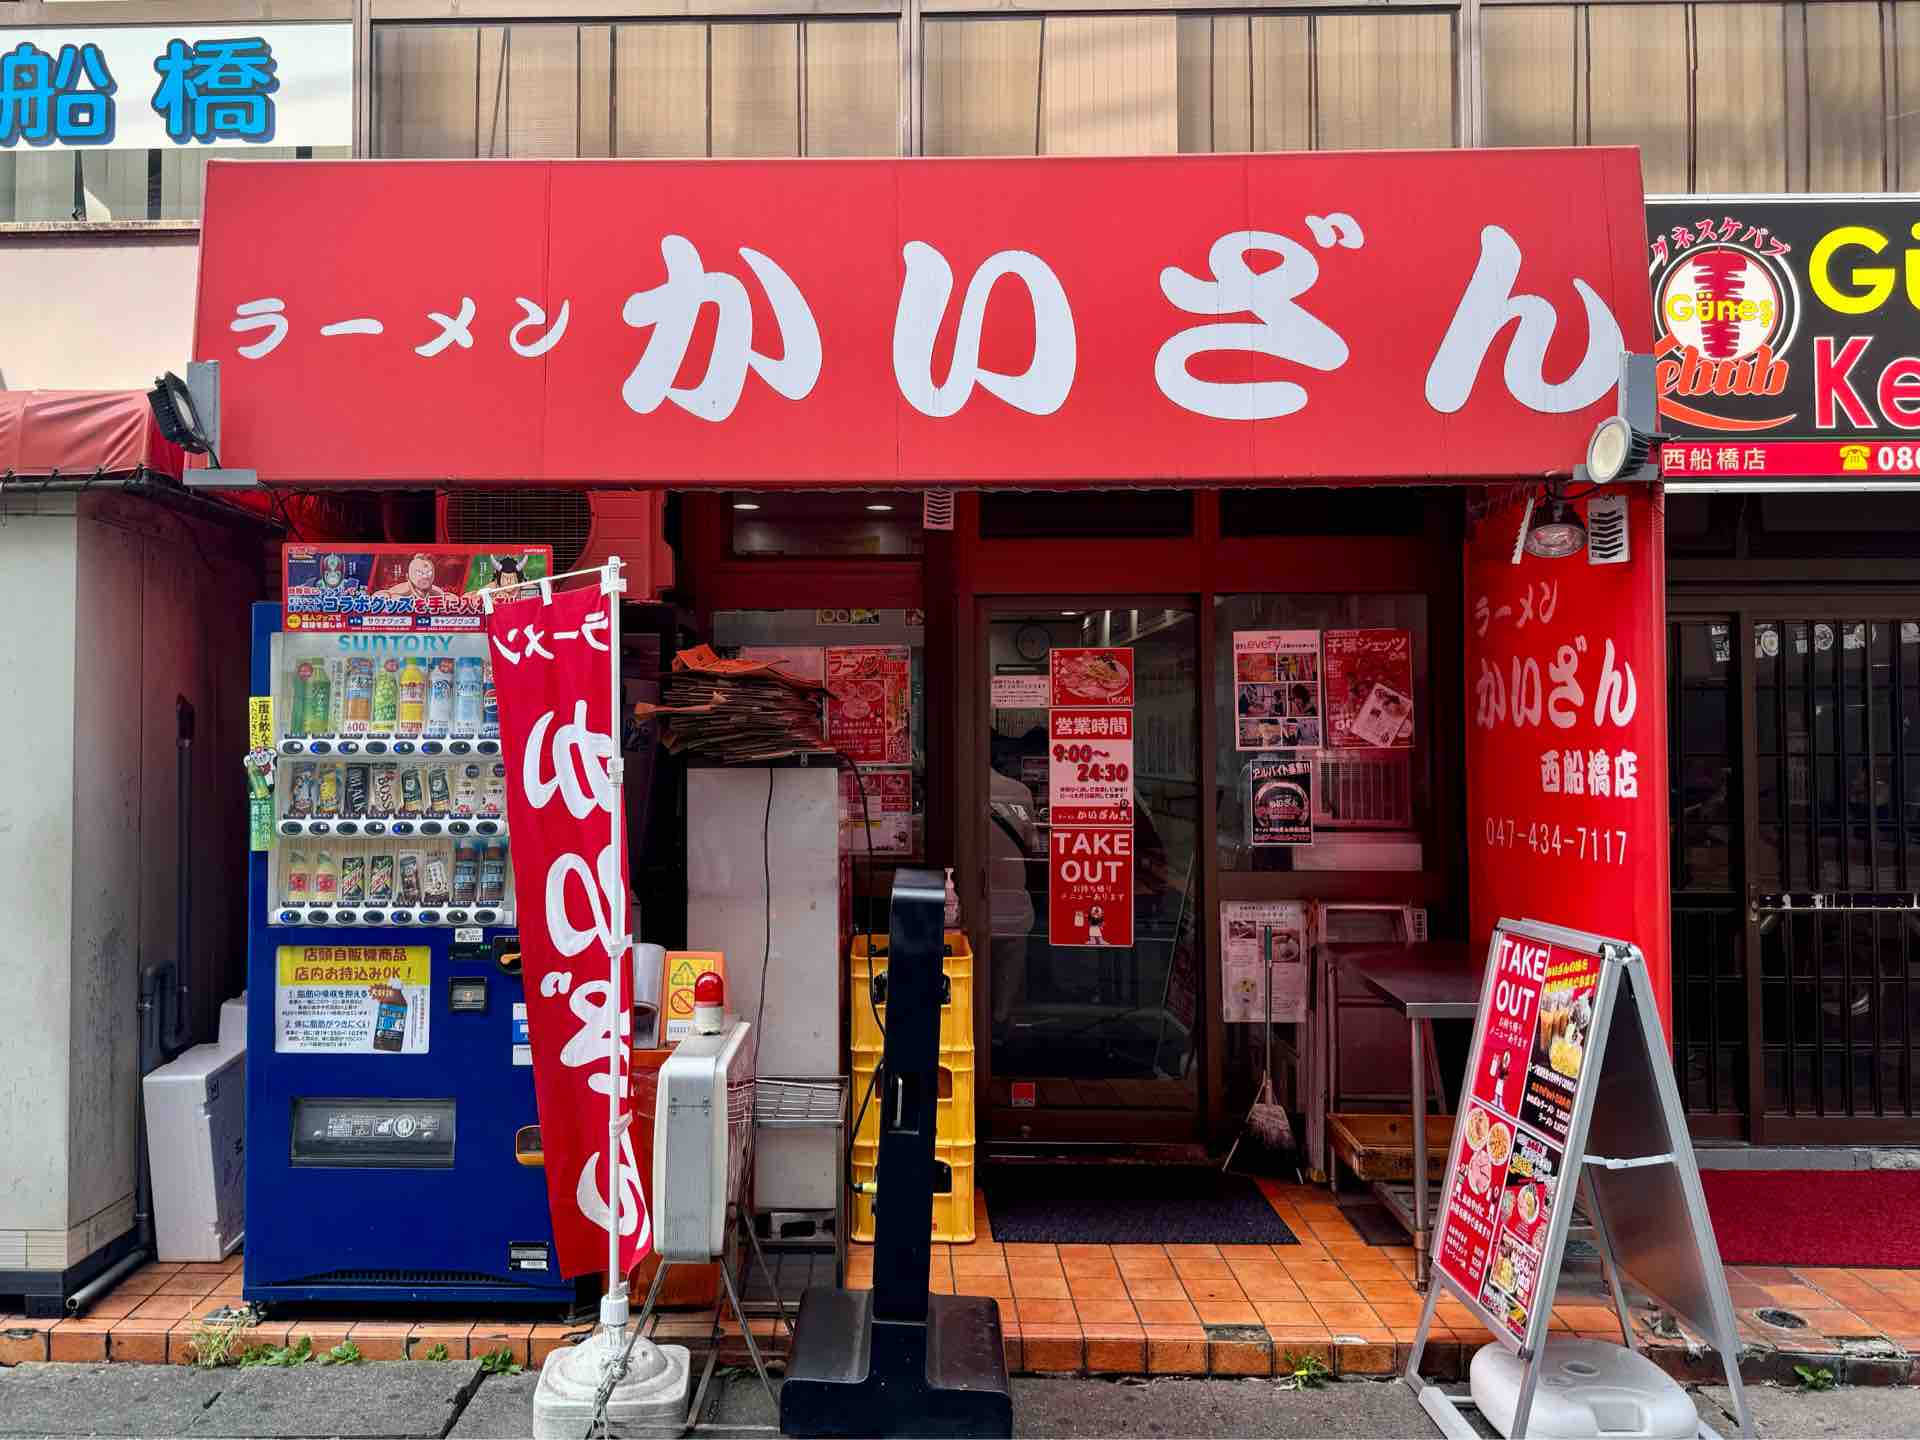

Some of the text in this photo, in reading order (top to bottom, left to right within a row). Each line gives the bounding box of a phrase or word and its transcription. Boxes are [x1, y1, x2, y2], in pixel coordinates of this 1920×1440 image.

[0, 38, 280, 147] 船橋
[230, 212, 1624, 422] ラーメン かいざん
[1654, 338, 1790, 396] ebab
[1663, 447, 1766, 472] 西船橋店
[1475, 579, 1558, 637] ラーメン
[337, 634, 455, 652] SUNTORY
[1476, 634, 1637, 729] かいざん
[1055, 717, 1128, 736] 営業時間
[1076, 763, 1129, 782] 24:30
[1540, 749, 1638, 799] 西船橋店
[1053, 832, 1131, 856] TAKE
[1486, 818, 1627, 865] 047-434-7117
[1060, 860, 1123, 883] OUT
[1501, 939, 1547, 983] TAKE
[1495, 980, 1535, 1021] OUT
